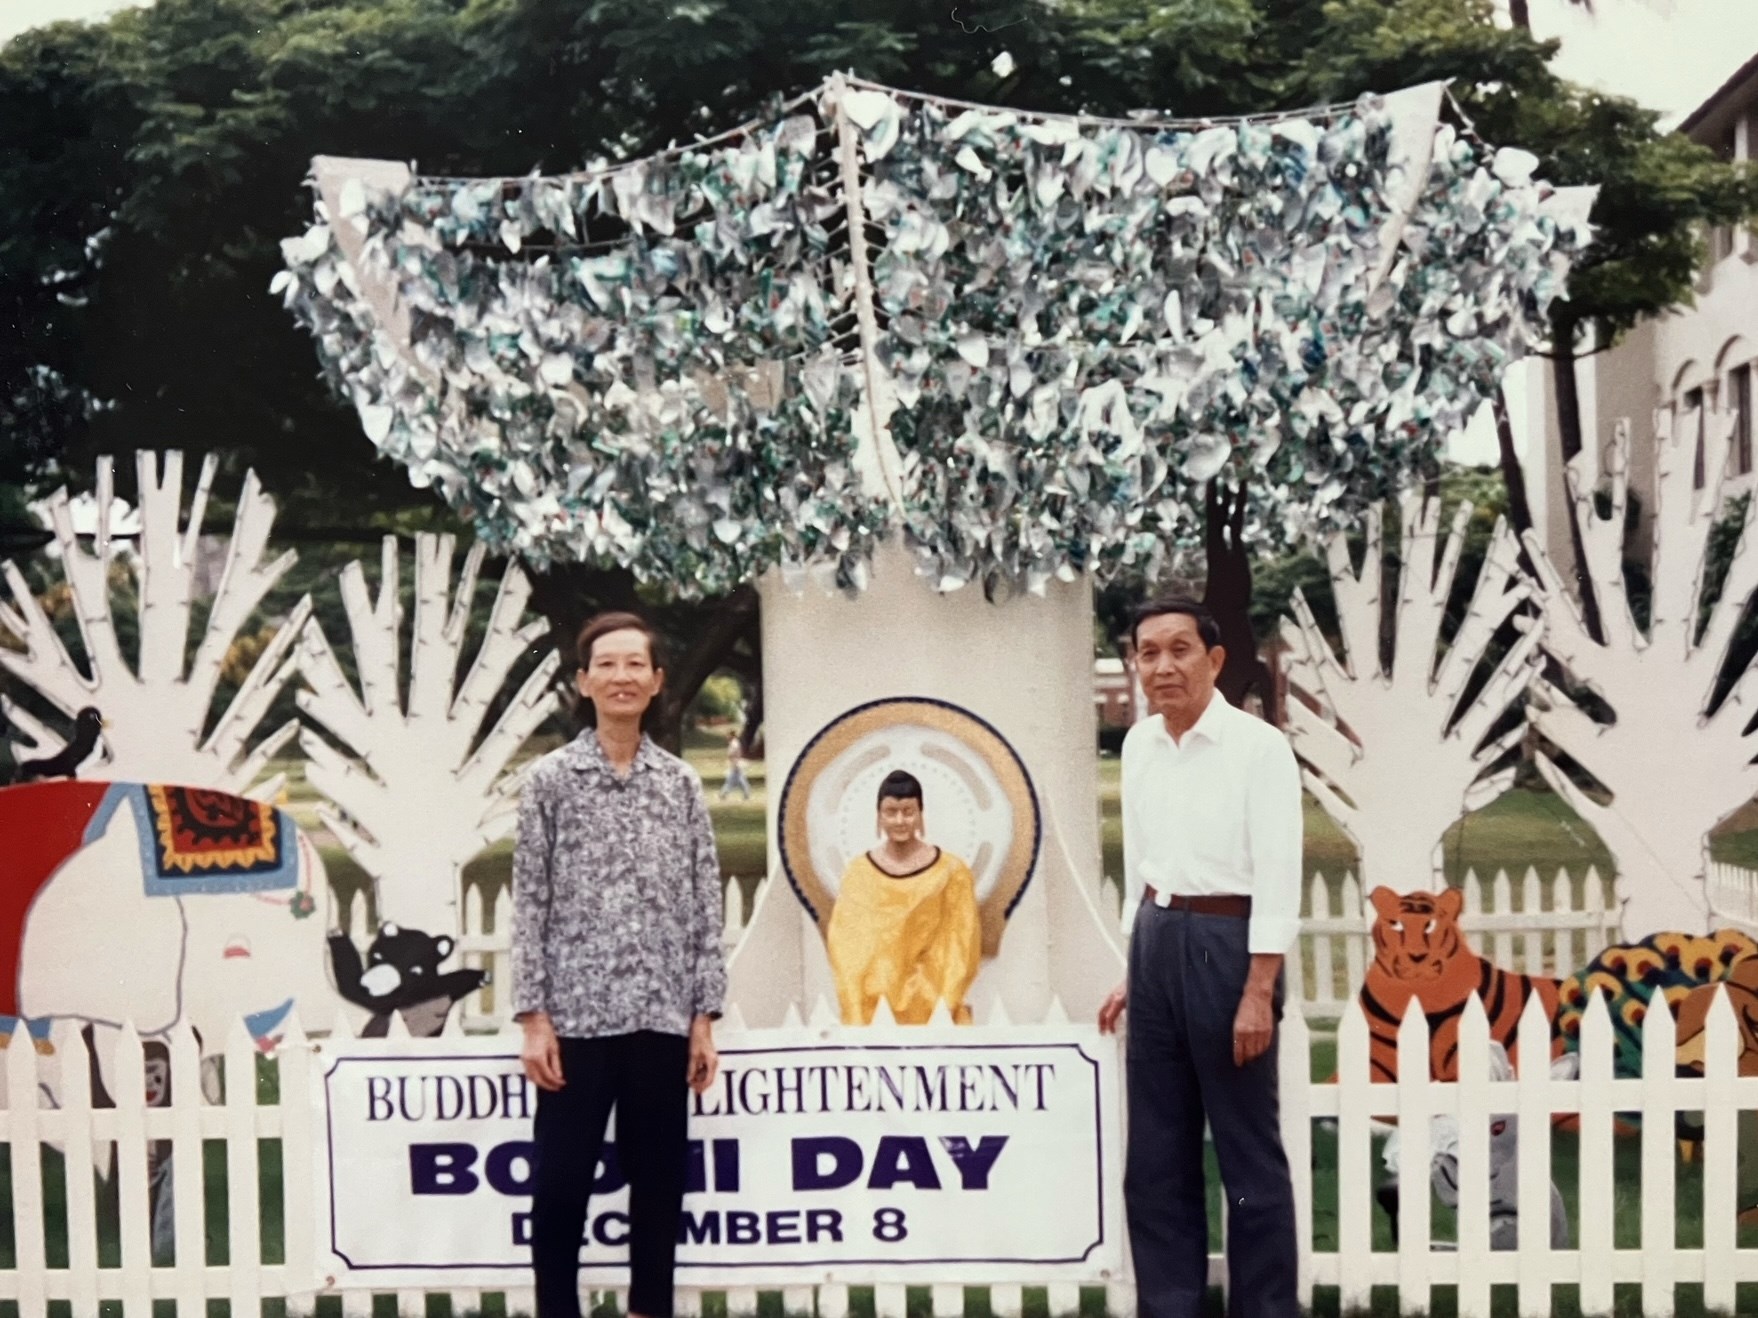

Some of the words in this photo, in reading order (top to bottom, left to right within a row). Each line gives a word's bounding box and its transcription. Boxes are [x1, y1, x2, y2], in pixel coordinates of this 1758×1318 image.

[366, 1073, 530, 1121] BUDDH
[691, 1063, 1055, 1117] LIGHTENMENT
[409, 1136, 740, 1197] BOI
[791, 1135, 1010, 1191] DAY
[512, 1208, 844, 1247] DCMBER
[872, 1207, 908, 1242] 8
